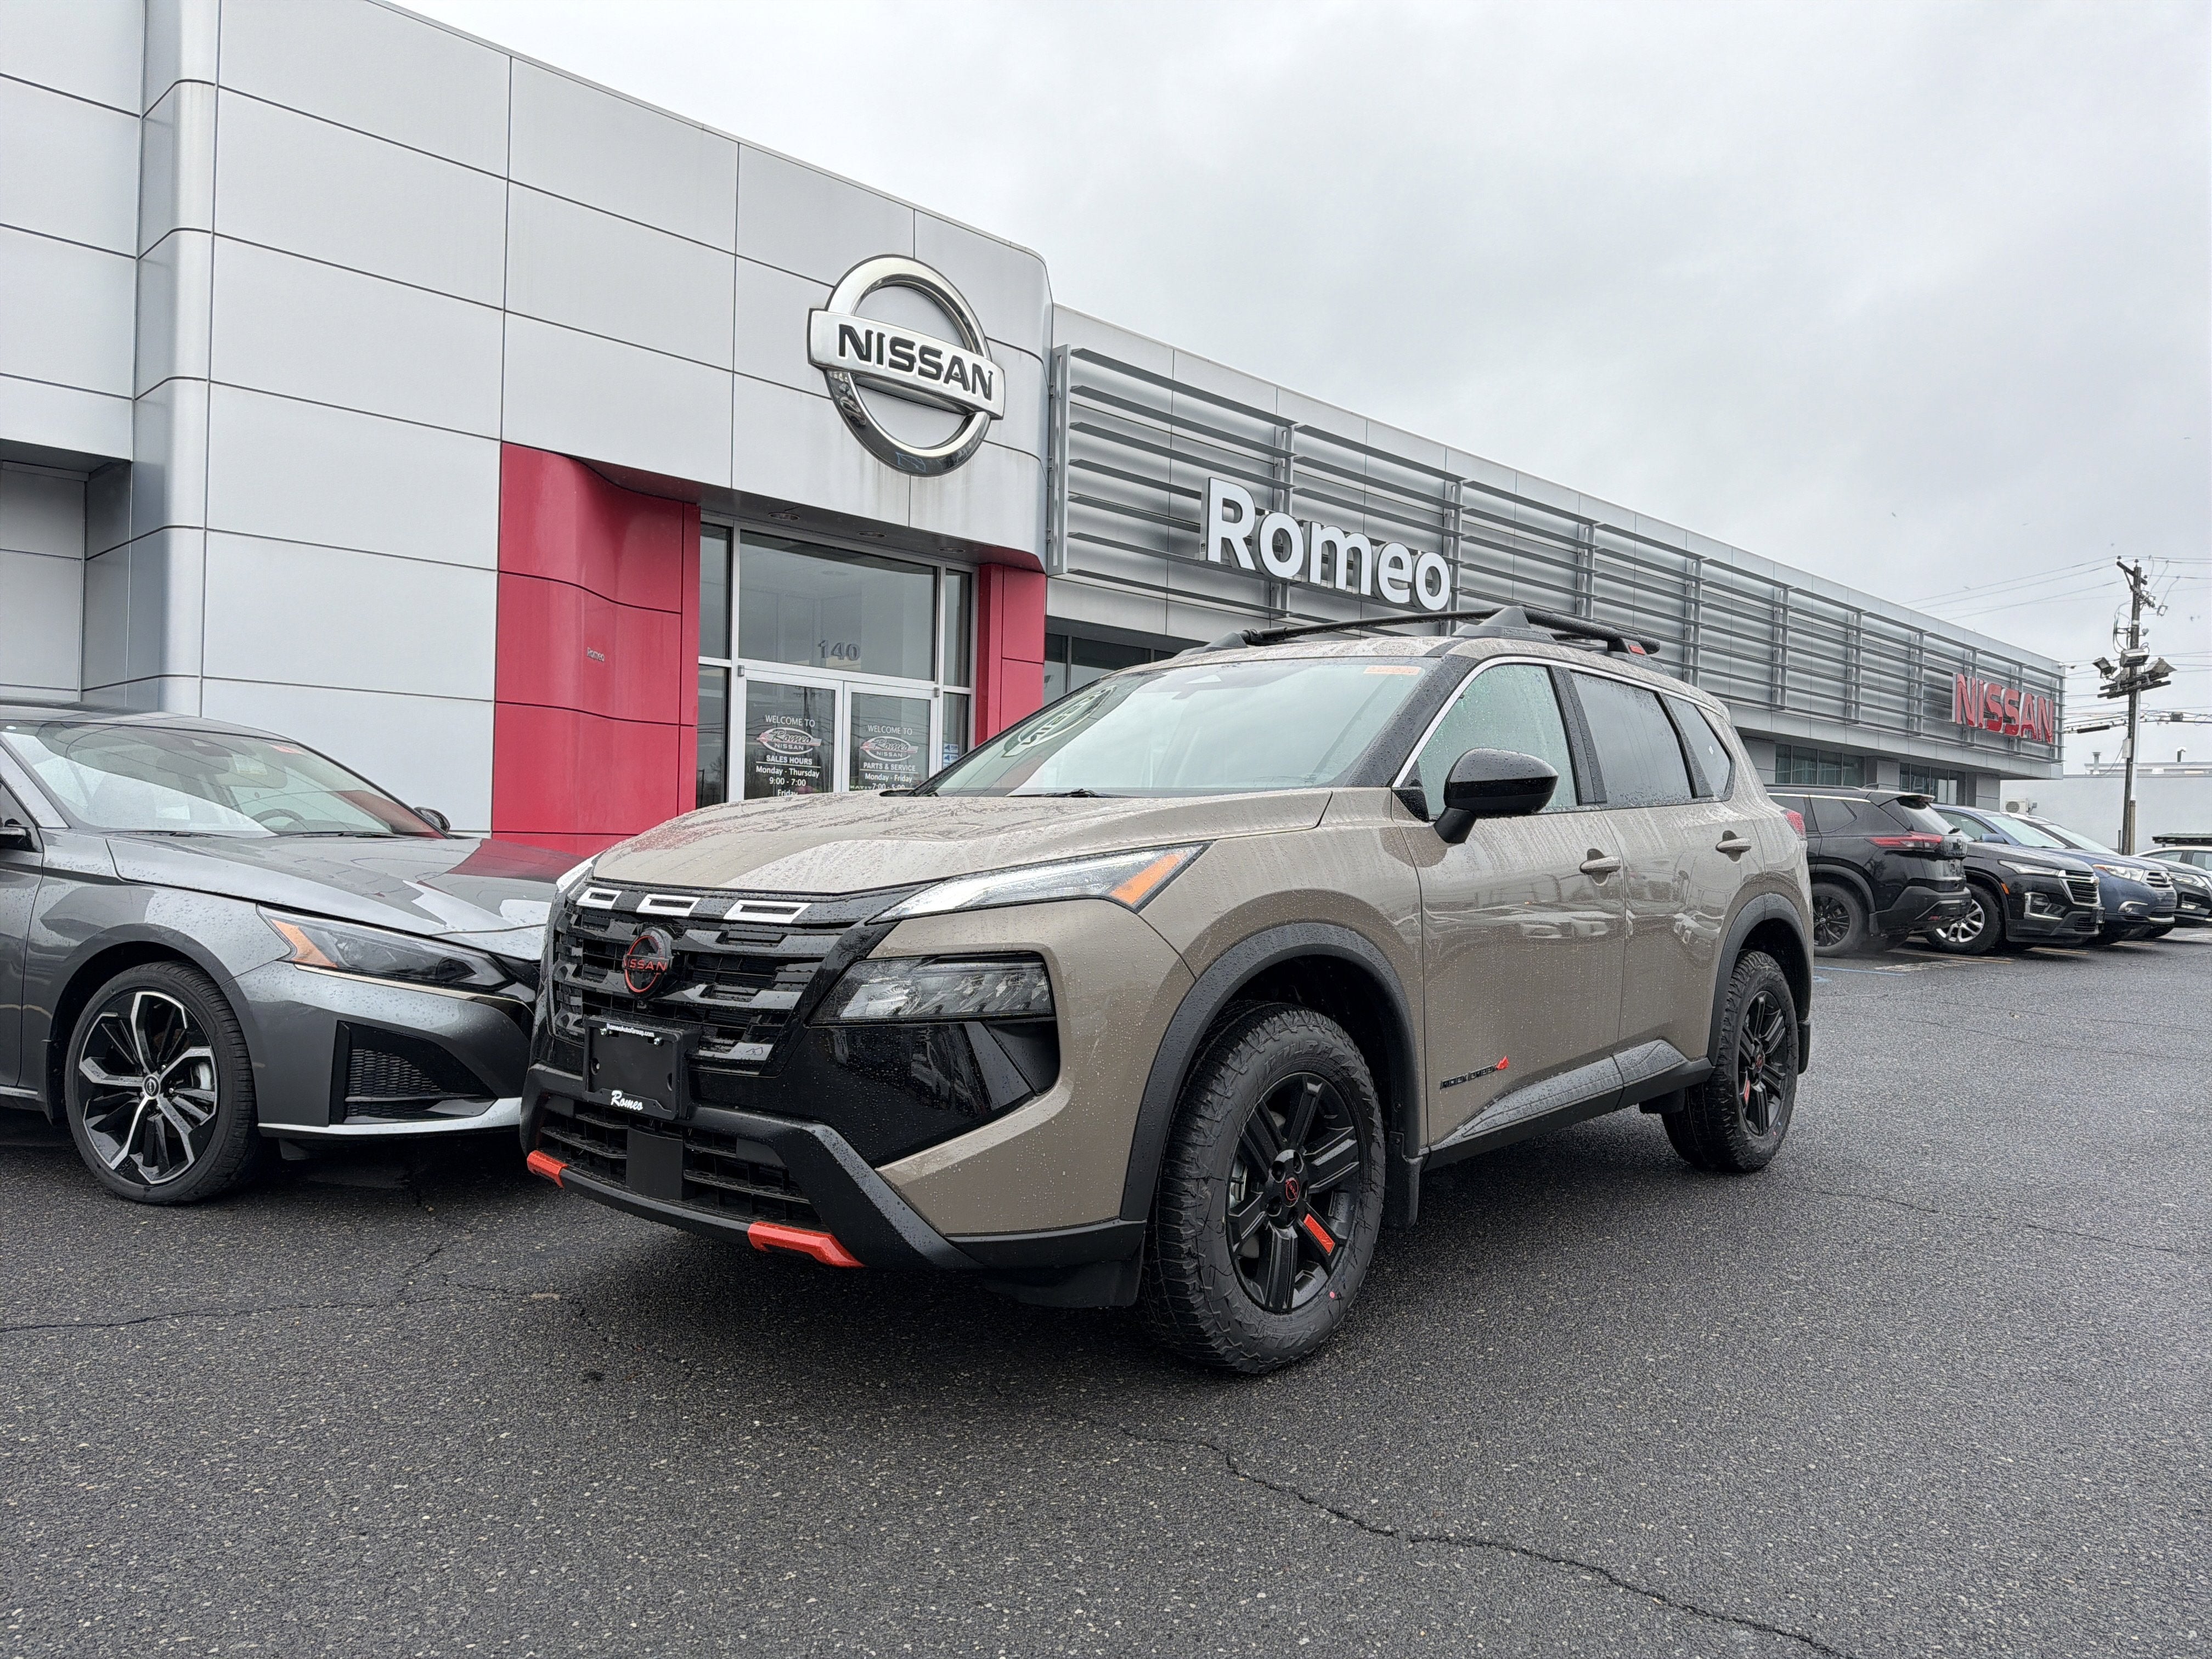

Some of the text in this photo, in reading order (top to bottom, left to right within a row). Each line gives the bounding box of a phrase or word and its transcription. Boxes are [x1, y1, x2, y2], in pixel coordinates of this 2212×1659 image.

[838, 324, 994, 402] NISSAN
[1204, 476, 1451, 611] Romeo
[587, 647, 605, 662] Romeo
[818, 640, 860, 661] 140
[1955, 673, 2054, 744] NISSAN
[765, 715, 815, 727] WELCOME TO
[771, 729, 811, 744] Romeo
[867, 725, 901, 735] WELCOME
[873, 737, 910, 752] Romeo
[766, 755, 812, 765] SALES HOURS
[756, 765, 783, 776] Monday
[789, 768, 820, 778] Thursday
[865, 772, 889, 782] Monday
[894, 775, 913, 783] Friday
[769, 777, 785, 785] 9:00
[606, 1023, 655, 1037] RomeoAutoGroup.com
[611, 1090, 644, 1111] Romeo
